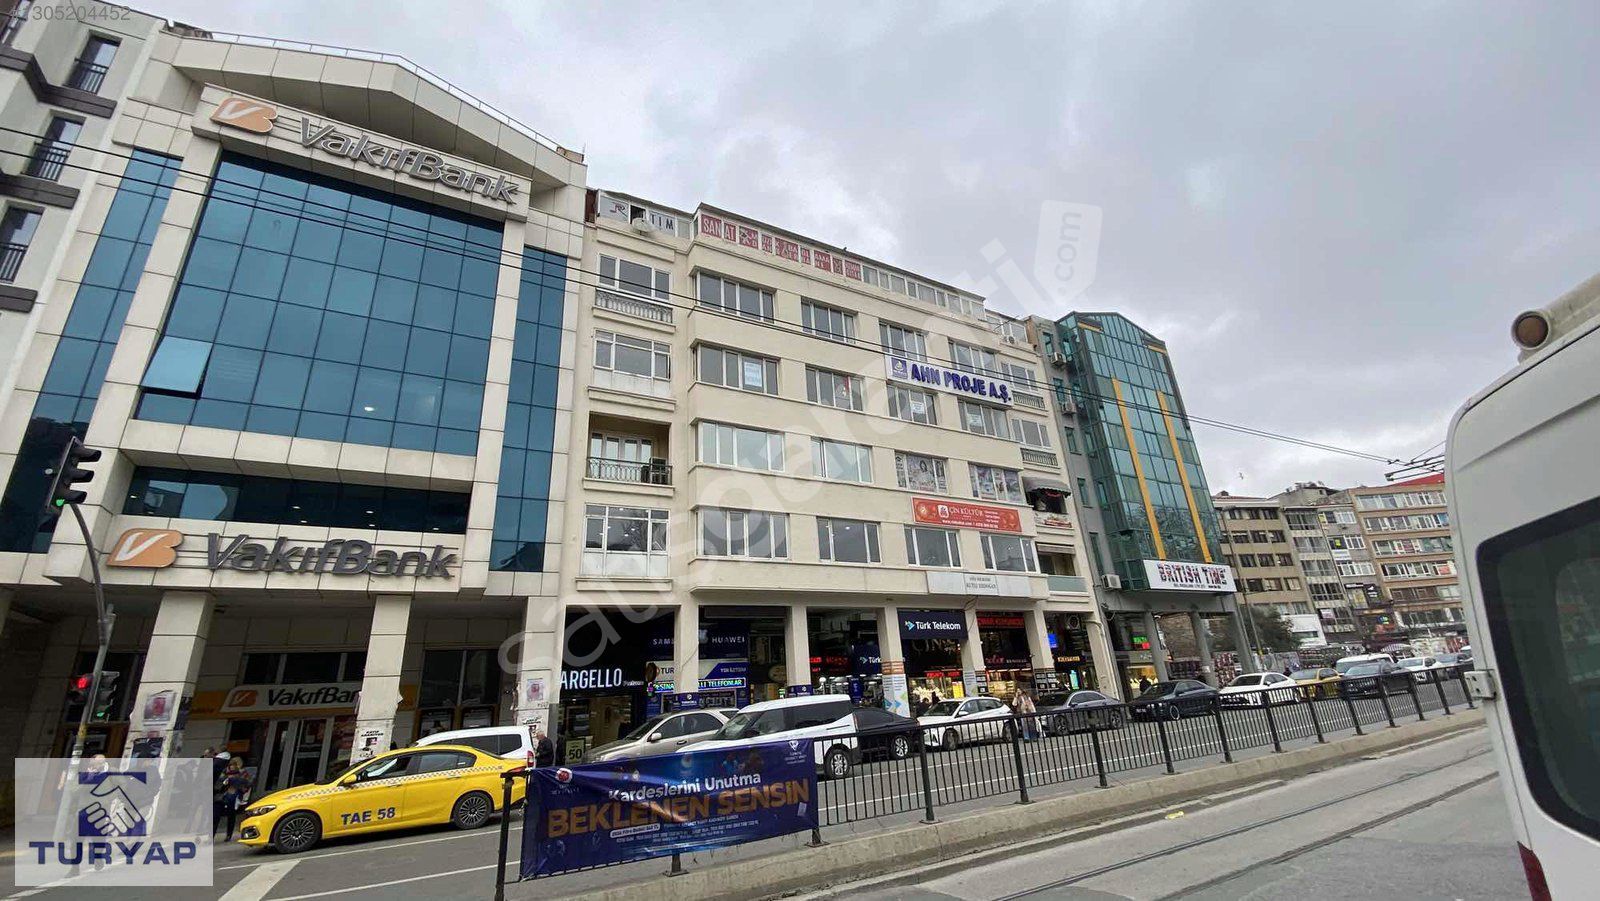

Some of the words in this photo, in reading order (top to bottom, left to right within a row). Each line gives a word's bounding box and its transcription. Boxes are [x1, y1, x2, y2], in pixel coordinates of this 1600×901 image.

[300, 116, 519, 204] VakıfBank
[911, 363, 941, 386] AHN
[944, 371, 987, 396] PROJE
[208, 532, 457, 580] VakıfBank
[1157, 563, 1202, 584] BRITISH
[1202, 567, 1227, 585] TIME
[915, 620, 931, 630] Türk
[932, 621, 961, 630] Telekom
[711, 636, 745, 644] HUAWEI
[705, 772, 761, 792] Unutma
[341, 810, 372, 825] TAE
[378, 807, 396, 820] 58
